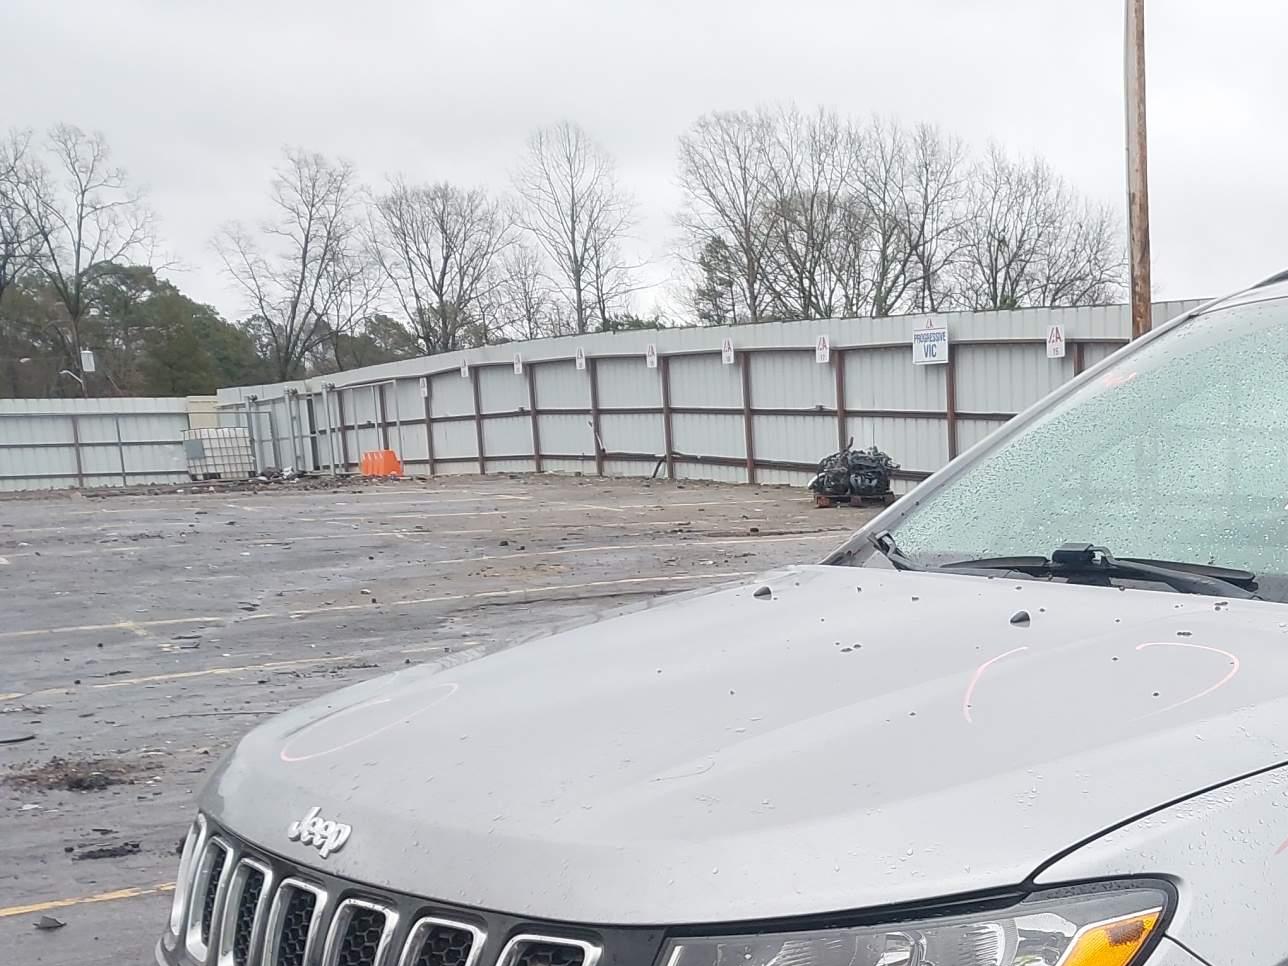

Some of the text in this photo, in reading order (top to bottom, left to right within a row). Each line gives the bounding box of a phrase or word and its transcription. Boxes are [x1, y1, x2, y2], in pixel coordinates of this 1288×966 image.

[913, 331, 946, 344] PROGRESSIVE
[923, 343, 937, 358] VIC
[288, 806, 352, 860] Jeep
